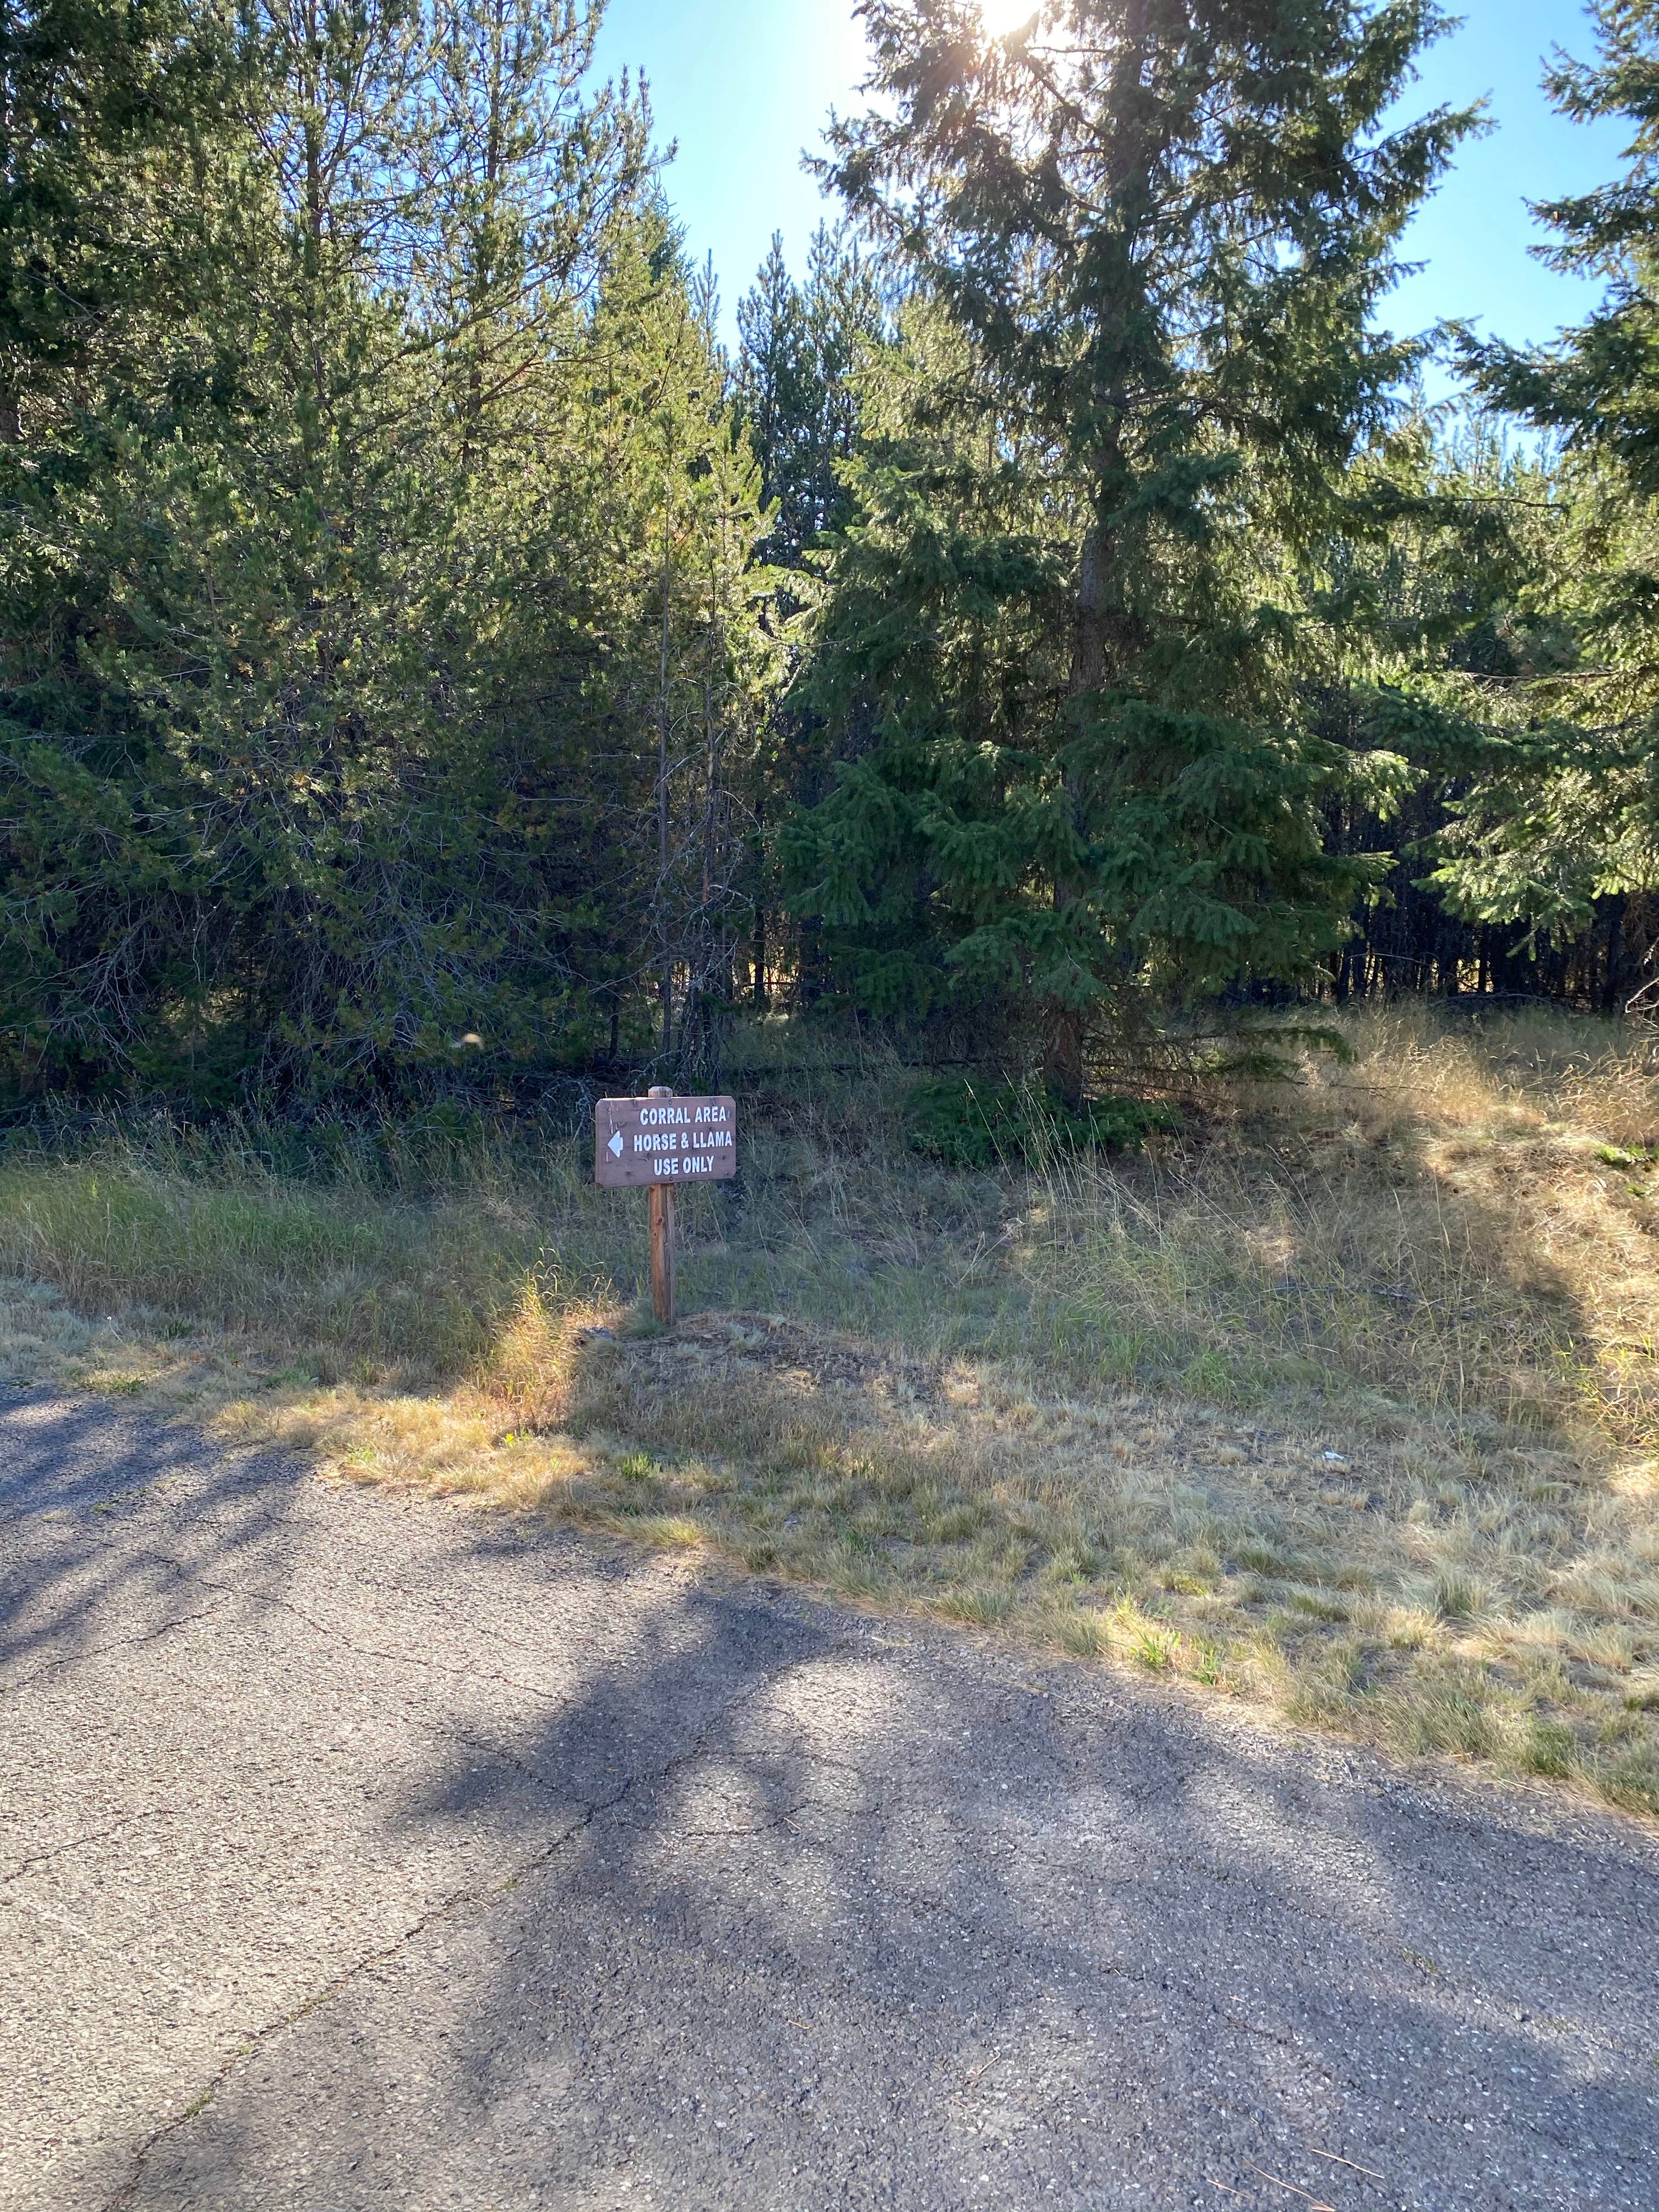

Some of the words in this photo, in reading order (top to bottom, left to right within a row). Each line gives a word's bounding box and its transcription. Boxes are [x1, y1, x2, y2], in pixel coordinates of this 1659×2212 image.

[640, 1107, 691, 1125] CORRAL
[695, 1106, 726, 1123] AREA
[634, 1133, 676, 1152] HORSE
[681, 1132, 689, 1148] &
[693, 1131, 732, 1148] LLAMA
[654, 1158, 679, 1176] USE
[682, 1155, 714, 1173] ONLY
